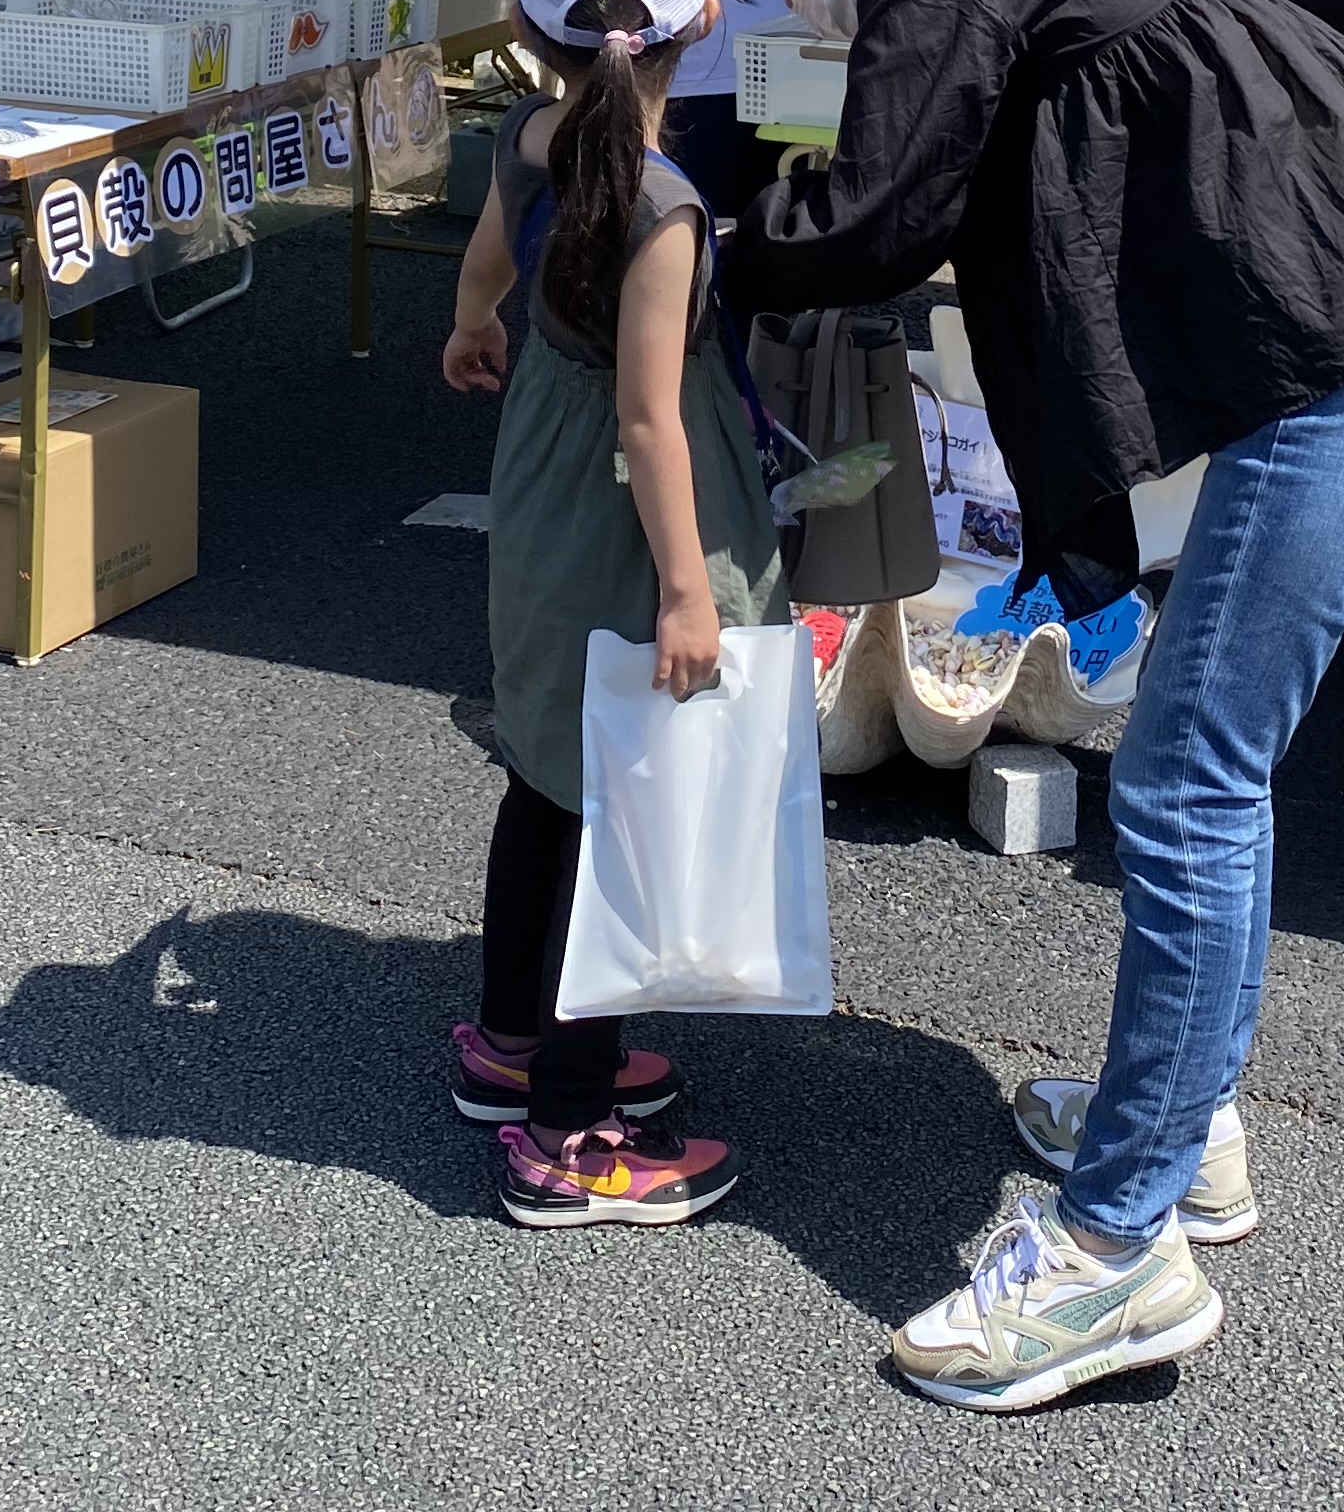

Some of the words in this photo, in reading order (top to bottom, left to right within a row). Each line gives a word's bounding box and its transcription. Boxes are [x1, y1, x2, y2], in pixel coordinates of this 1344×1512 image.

[43, 71, 400, 282] 貝殻の問屋さん
